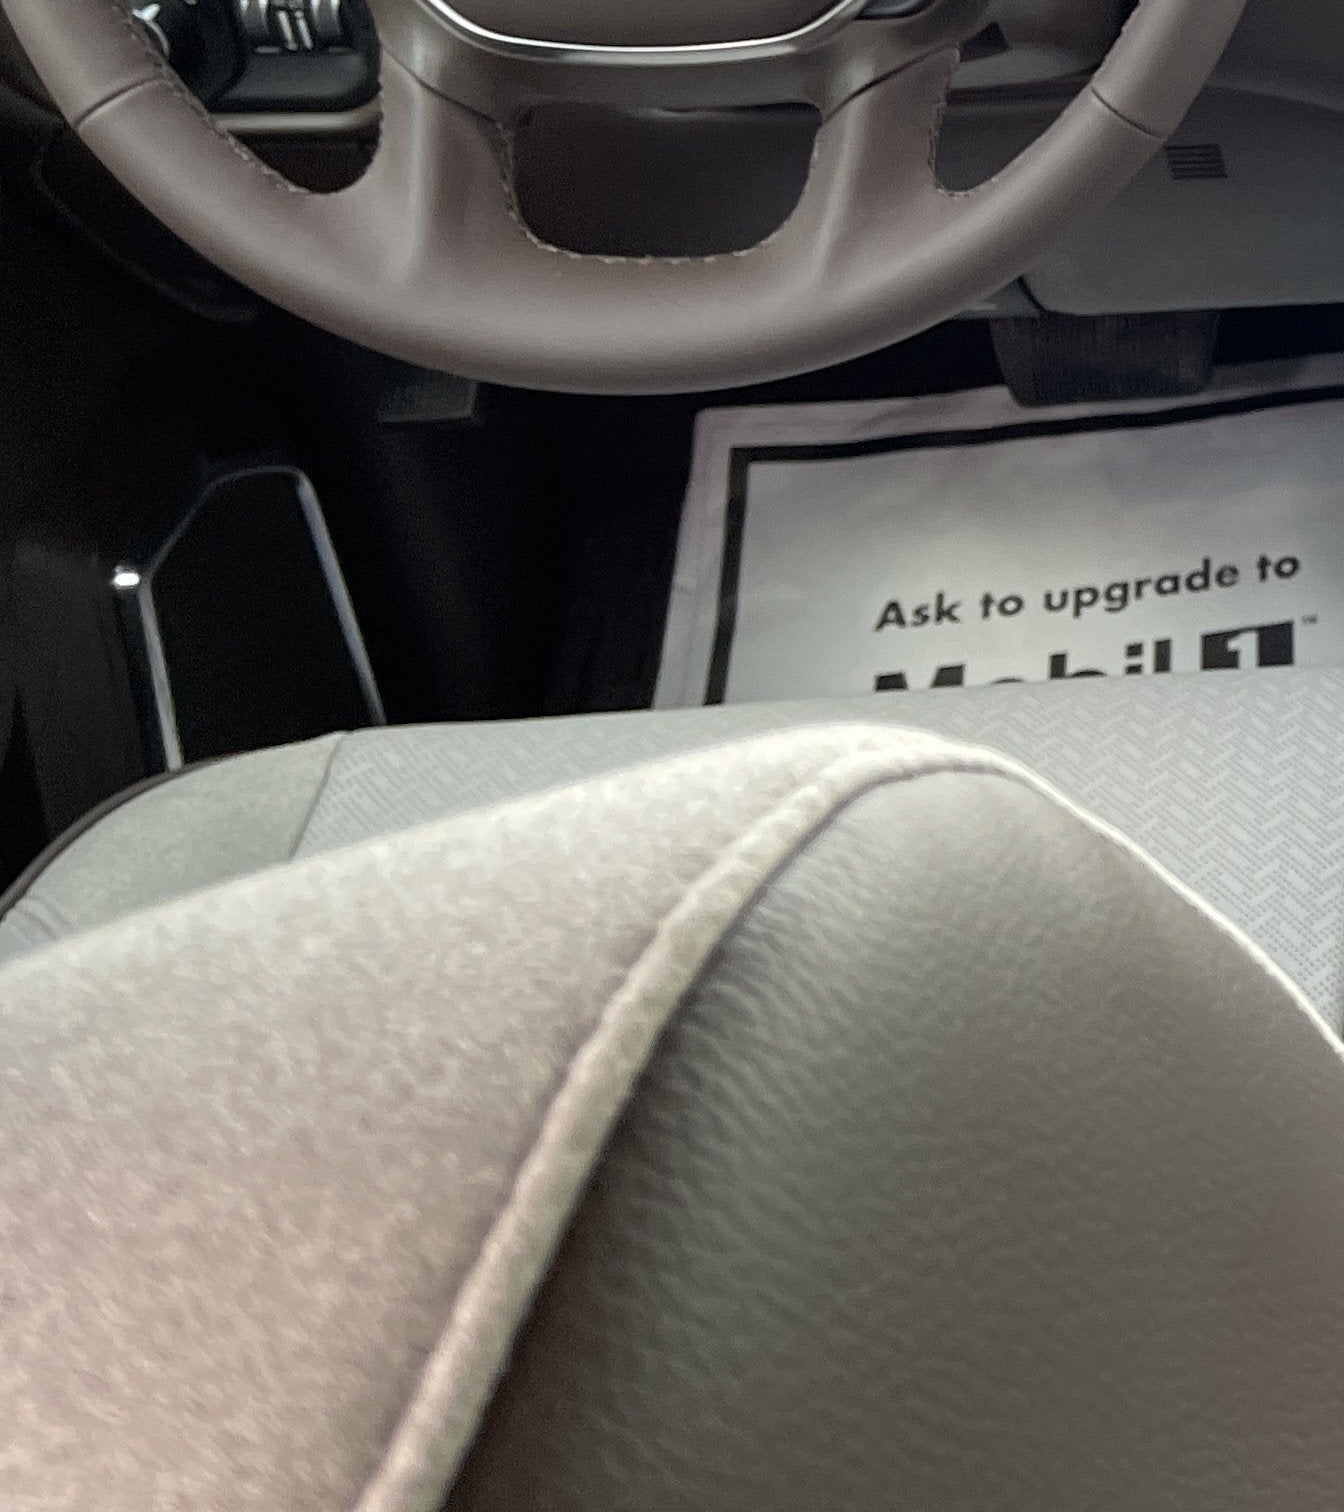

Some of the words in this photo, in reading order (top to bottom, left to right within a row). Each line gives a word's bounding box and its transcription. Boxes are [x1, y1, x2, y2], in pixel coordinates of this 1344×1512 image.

[874, 590, 963, 634] Ask
[980, 587, 1024, 619] to
[1042, 558, 1242, 620] upgrade
[1257, 551, 1301, 582] to
